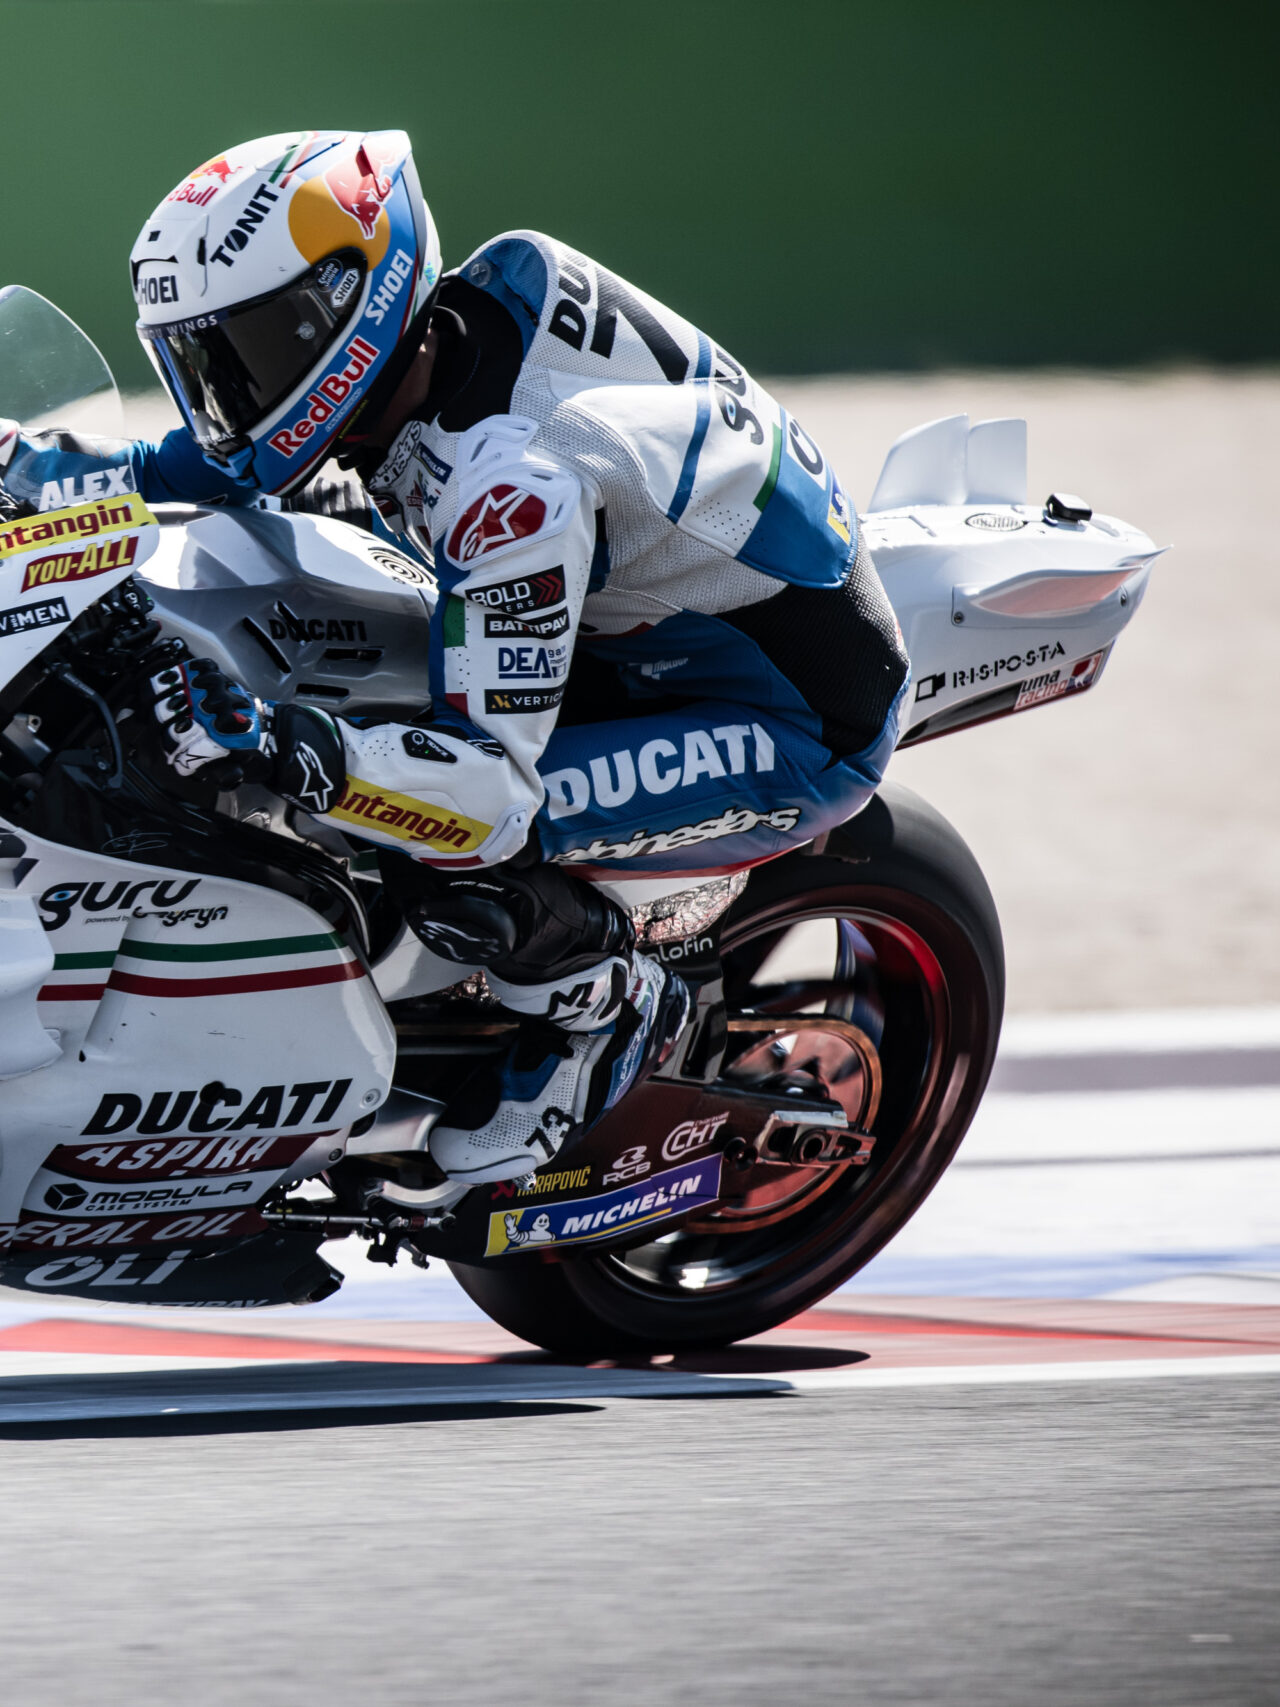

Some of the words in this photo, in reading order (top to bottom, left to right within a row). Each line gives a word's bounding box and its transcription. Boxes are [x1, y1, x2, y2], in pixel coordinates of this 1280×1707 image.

[176, 183, 219, 207] Bull
[138, 275, 179, 305] HOEI
[335, 273, 357, 302] SHOEI
[364, 248, 414, 326] SHOEI
[167, 315, 218, 336] WINGS
[267, 392, 335, 458] Red
[318, 334, 380, 405] Bull
[39, 465, 133, 512] ALEX
[26, 535, 136, 588] YOU-ALL
[18, 603, 66, 626] MEN
[498, 647, 552, 679] DEA
[541, 722, 775, 821] DUCATI
[39, 878, 202, 931] guru
[80, 1079, 353, 1136] DUCATI
[524, 1106, 576, 1159] 73
[603, 1161, 651, 1186] RCB
[85, 1200, 129, 1212] CASE
[133, 1199, 193, 1209] SYSTEM
[561, 1175, 702, 1235] MICHELIN
[152, 1211, 246, 1241] OIL
